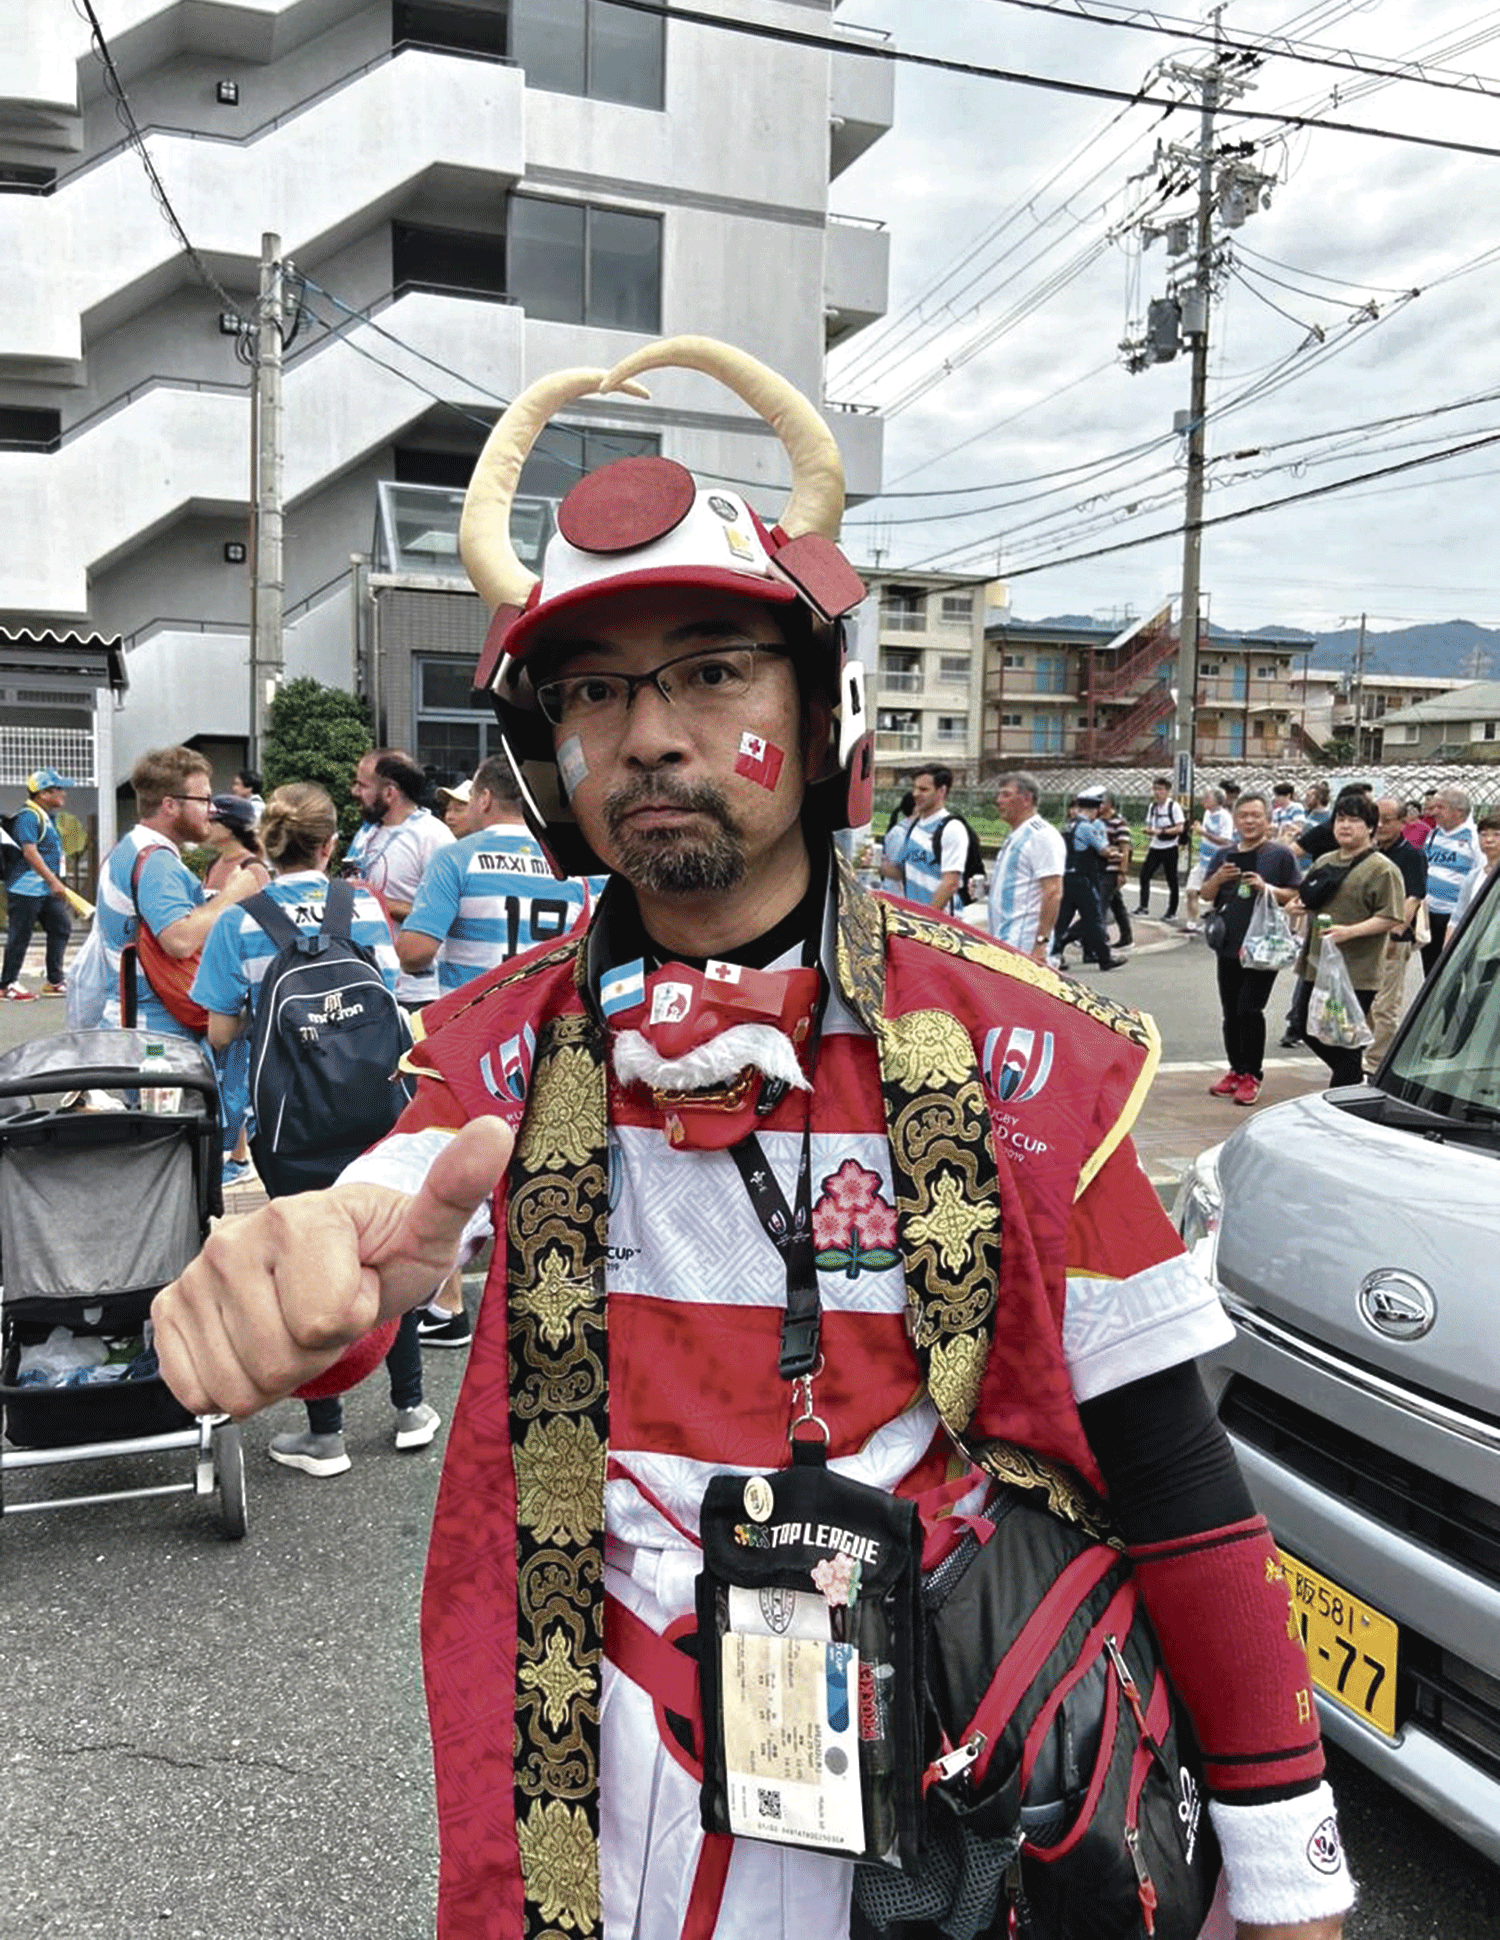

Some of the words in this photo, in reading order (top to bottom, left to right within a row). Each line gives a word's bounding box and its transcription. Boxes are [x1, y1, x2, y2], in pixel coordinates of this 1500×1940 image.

[478, 853, 526, 872] MAXI
[530, 858, 551, 875] MI
[771, 1522, 802, 1548] TOP
[802, 1522, 881, 1565] LEAGUE
[1318, 1587, 1354, 1635] 581
